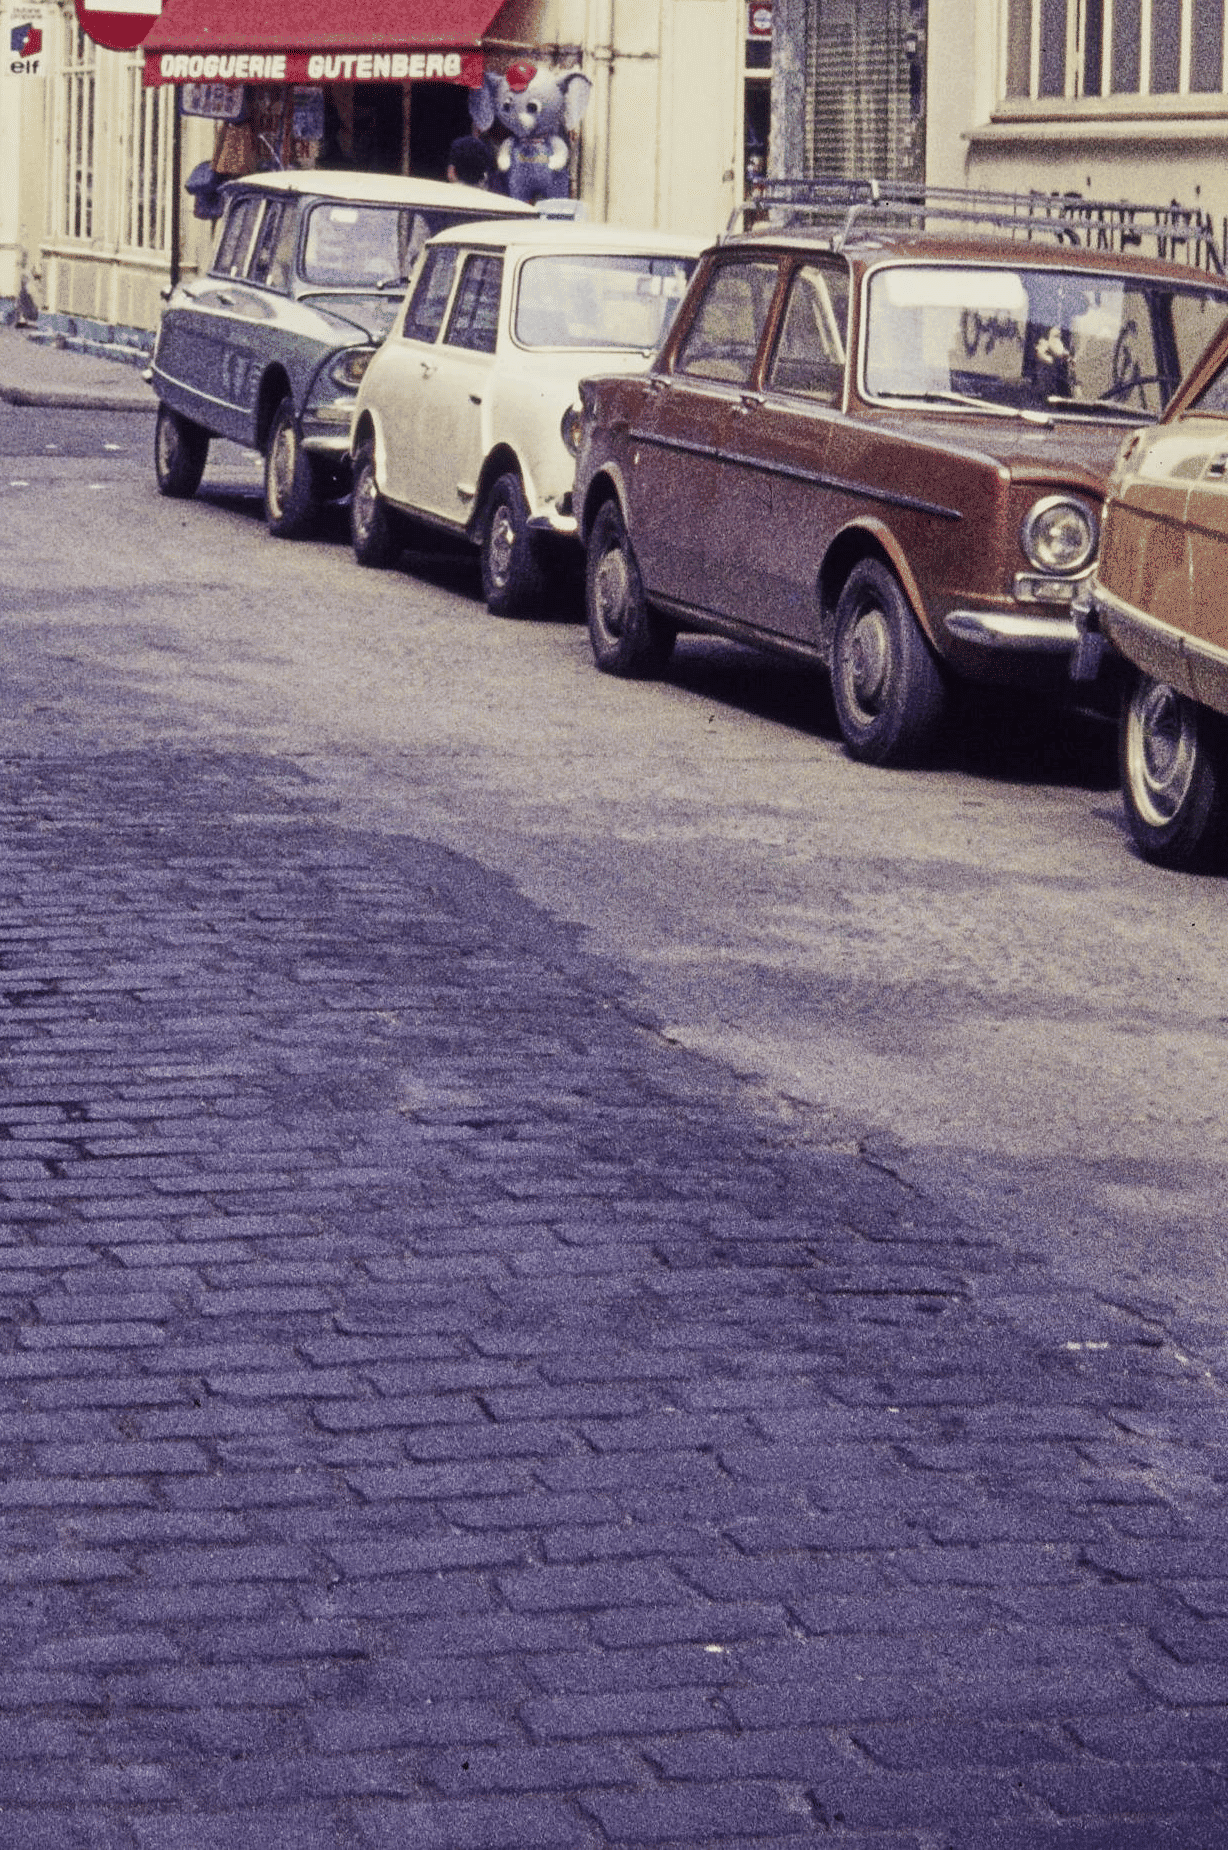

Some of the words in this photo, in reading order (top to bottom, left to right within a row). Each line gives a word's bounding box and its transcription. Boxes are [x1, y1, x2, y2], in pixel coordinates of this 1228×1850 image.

[10, 60, 40, 74] elf
[160, 53, 288, 80] DROGUERIE
[307, 52, 462, 80] GUTENBERG
